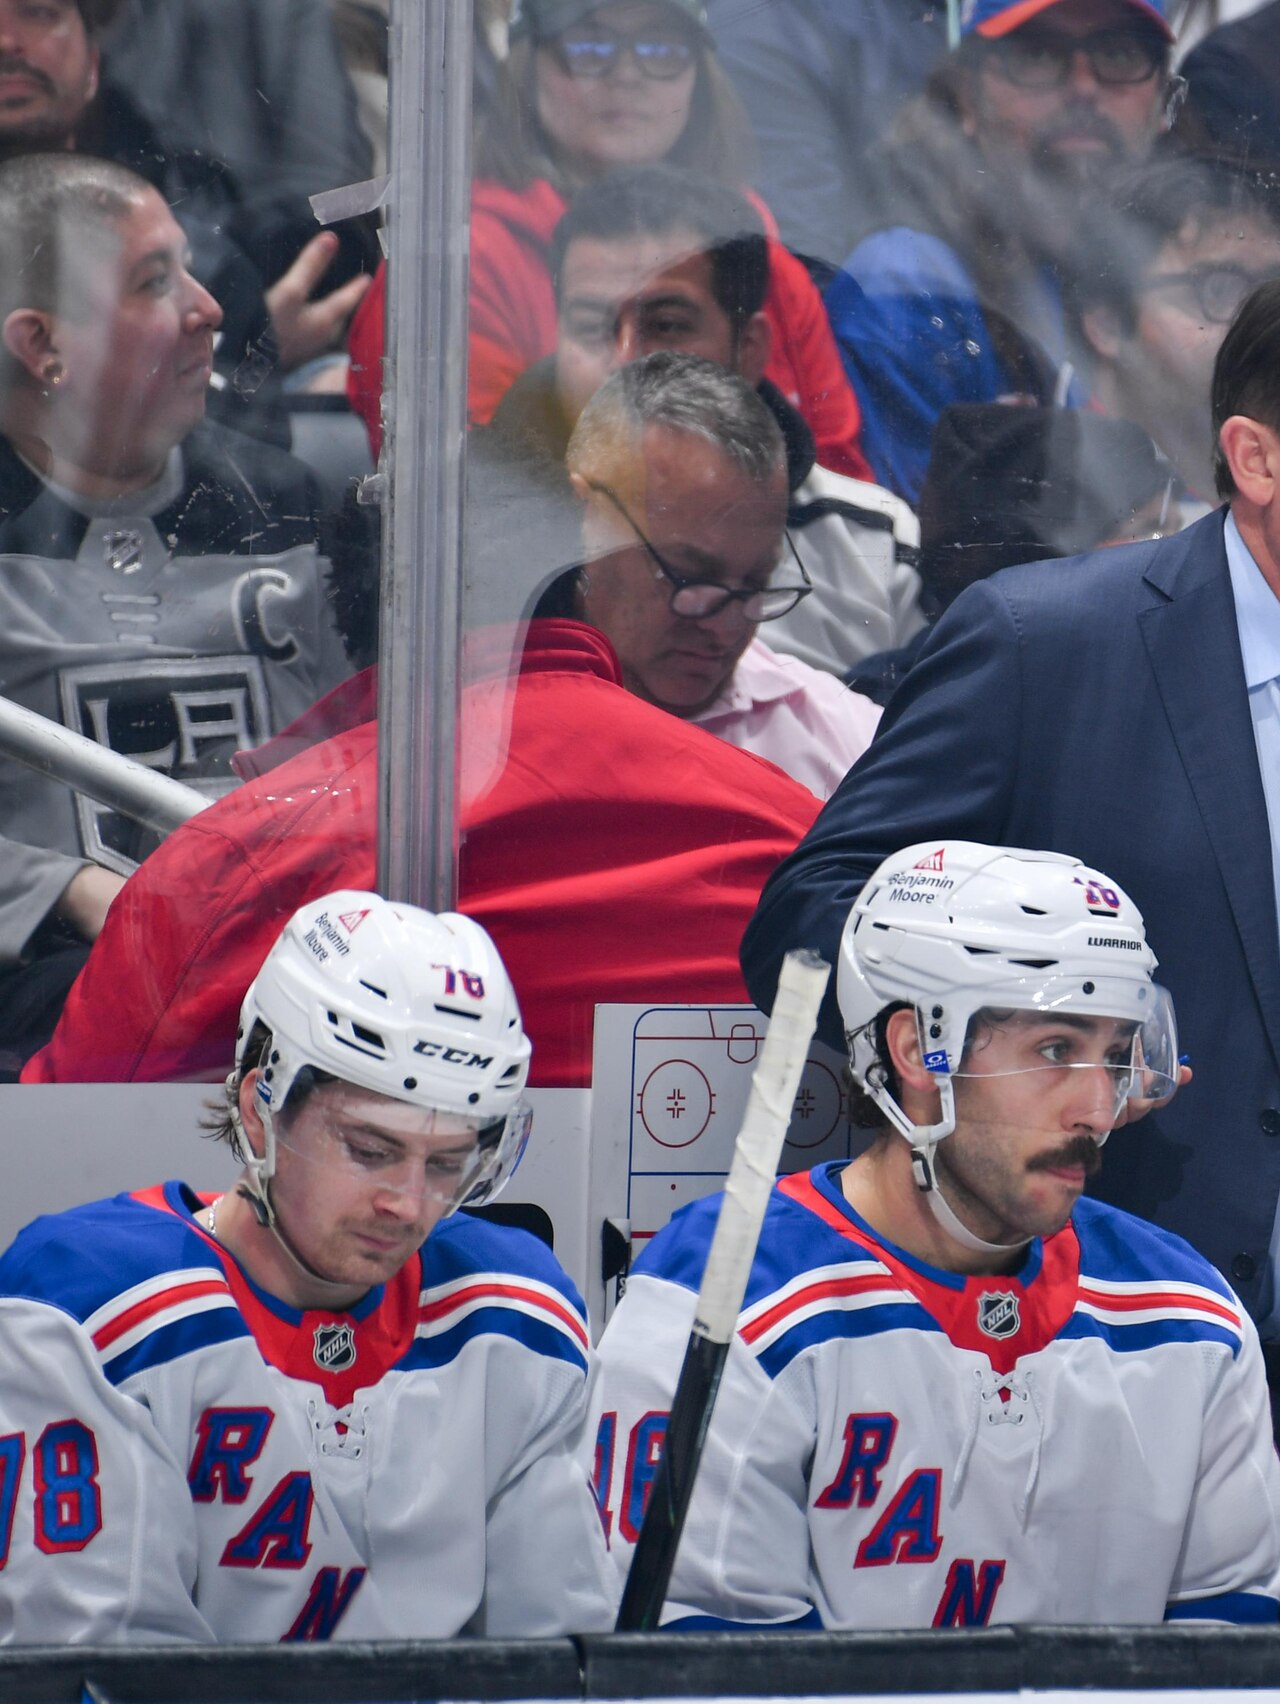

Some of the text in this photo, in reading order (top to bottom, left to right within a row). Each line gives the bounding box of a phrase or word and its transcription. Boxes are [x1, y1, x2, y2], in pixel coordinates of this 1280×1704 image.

[231, 567, 300, 666] C
[888, 871, 955, 890] Benjamin
[889, 887, 936, 904] Moore
[1087, 936, 1143, 952] WARRIOR
[412, 1038, 495, 1070] CCM
